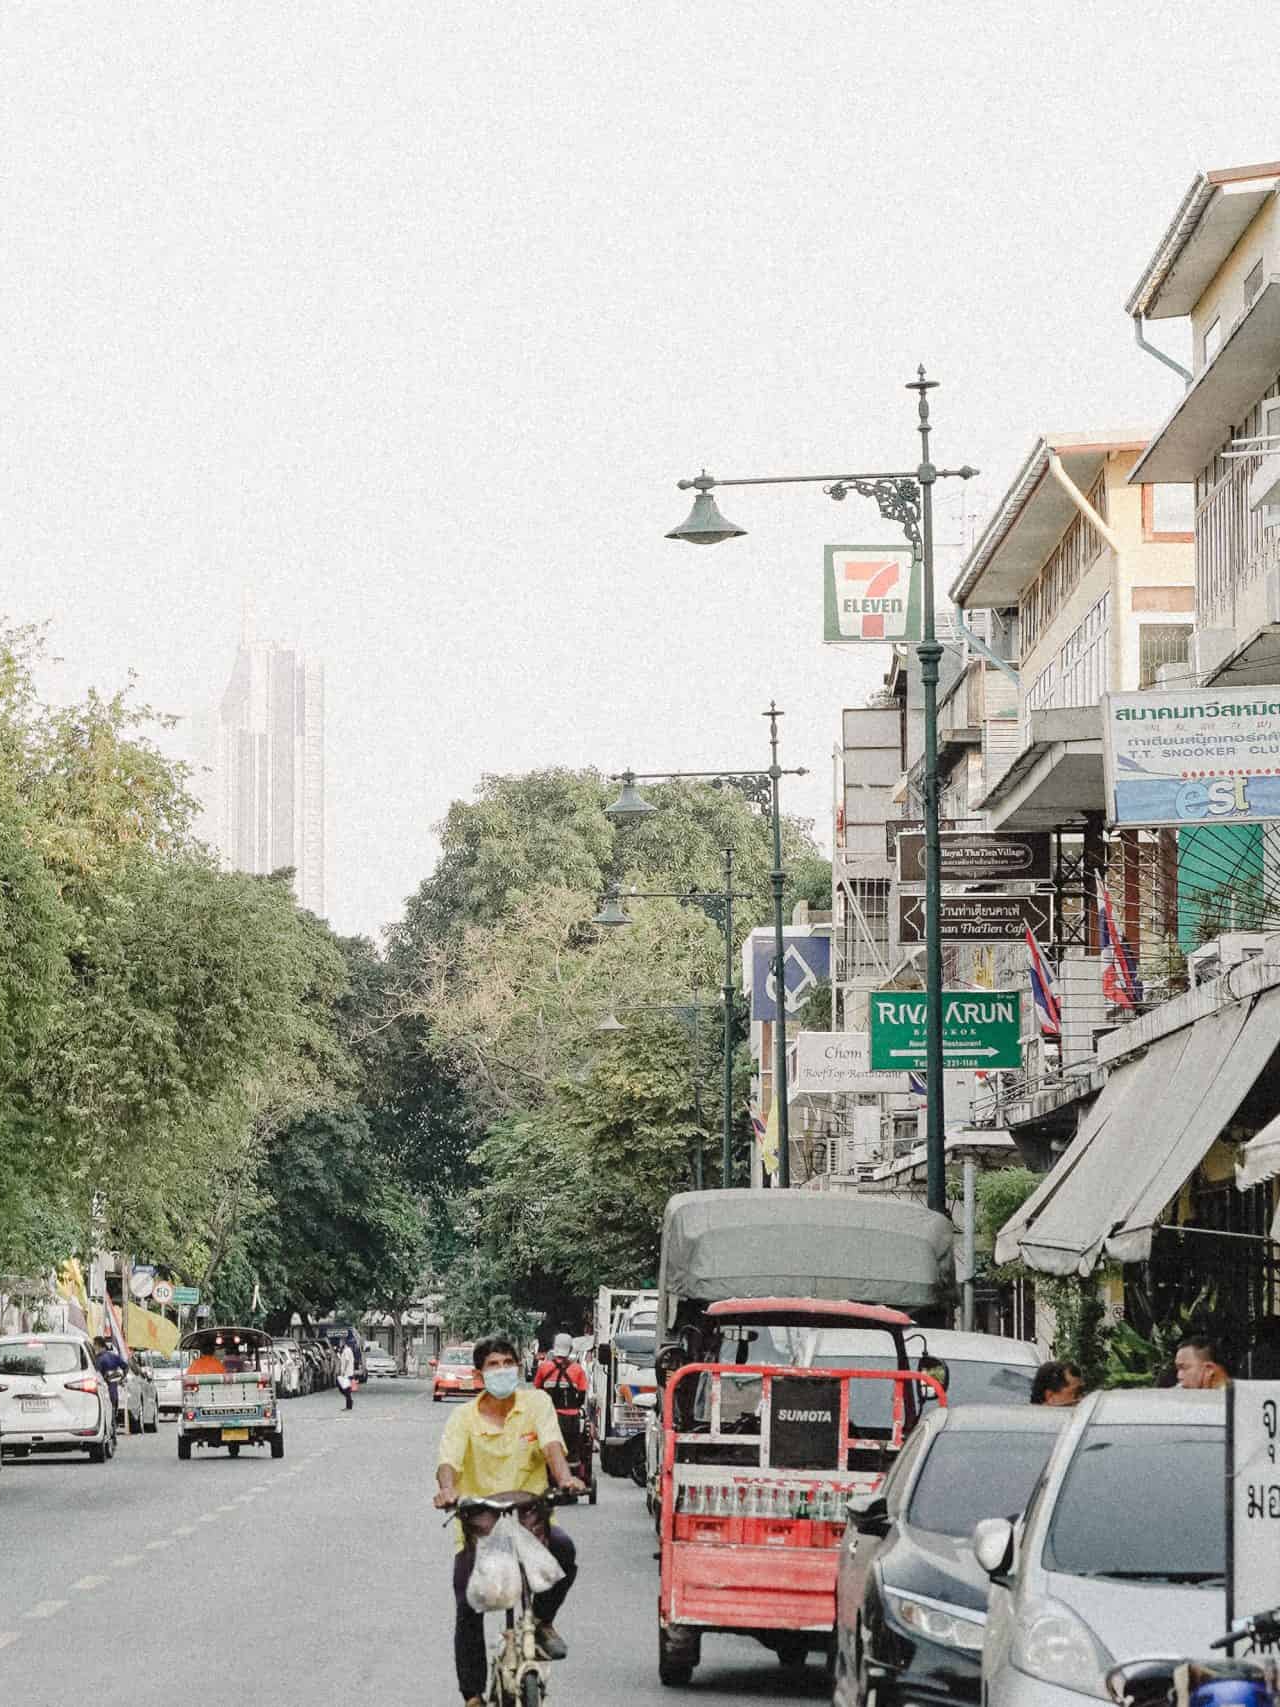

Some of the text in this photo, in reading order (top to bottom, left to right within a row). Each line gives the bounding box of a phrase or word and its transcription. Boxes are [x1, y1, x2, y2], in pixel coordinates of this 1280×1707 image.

[1128, 750, 1154, 759] T.T.
[1161, 747, 1236, 758] SNOOKER
[1176, 777, 1251, 818] est
[824, 1046, 862, 1059] Chom
[778, 1409, 832, 1422] SUMOTA
